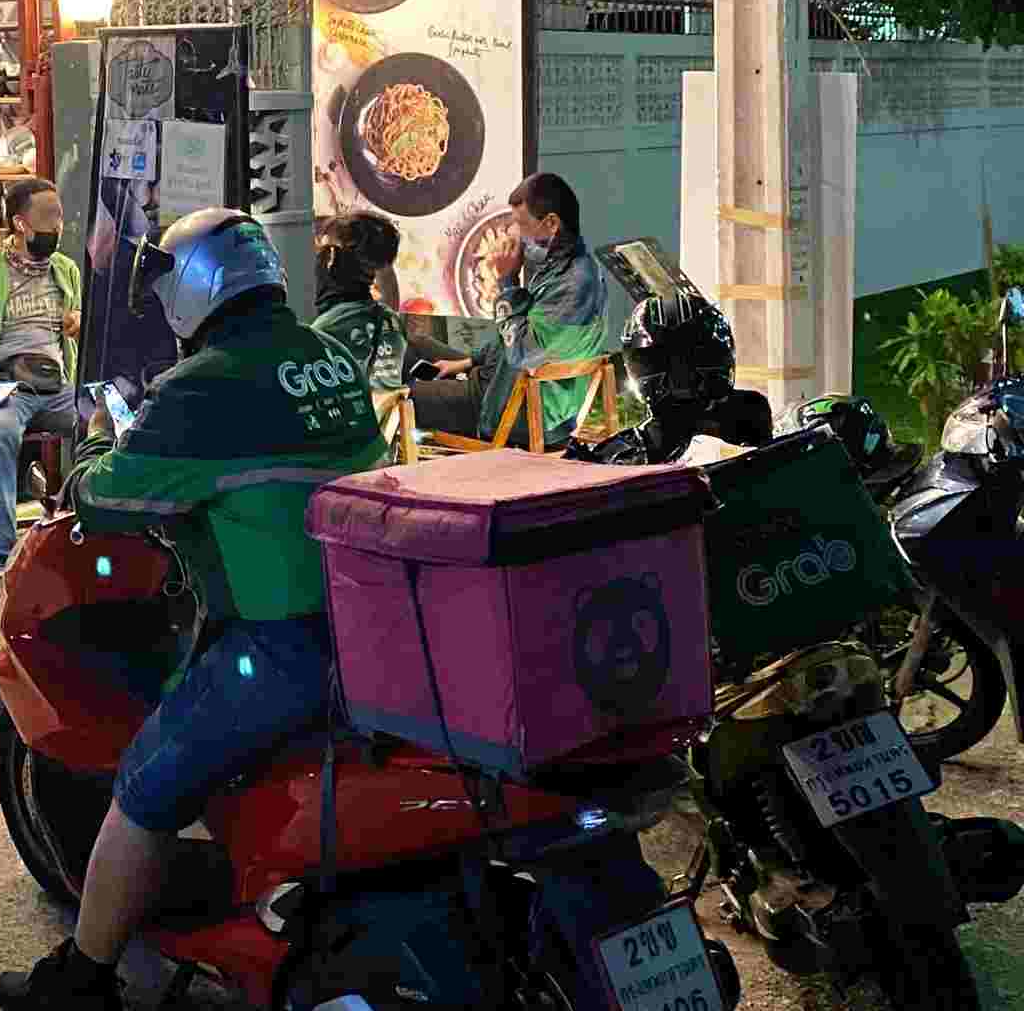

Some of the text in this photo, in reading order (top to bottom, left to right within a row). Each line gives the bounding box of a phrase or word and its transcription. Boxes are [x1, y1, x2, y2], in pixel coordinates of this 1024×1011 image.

[278, 348, 355, 397] Grab
[736, 532, 857, 606] Grab
[830, 769, 913, 816] 5015
